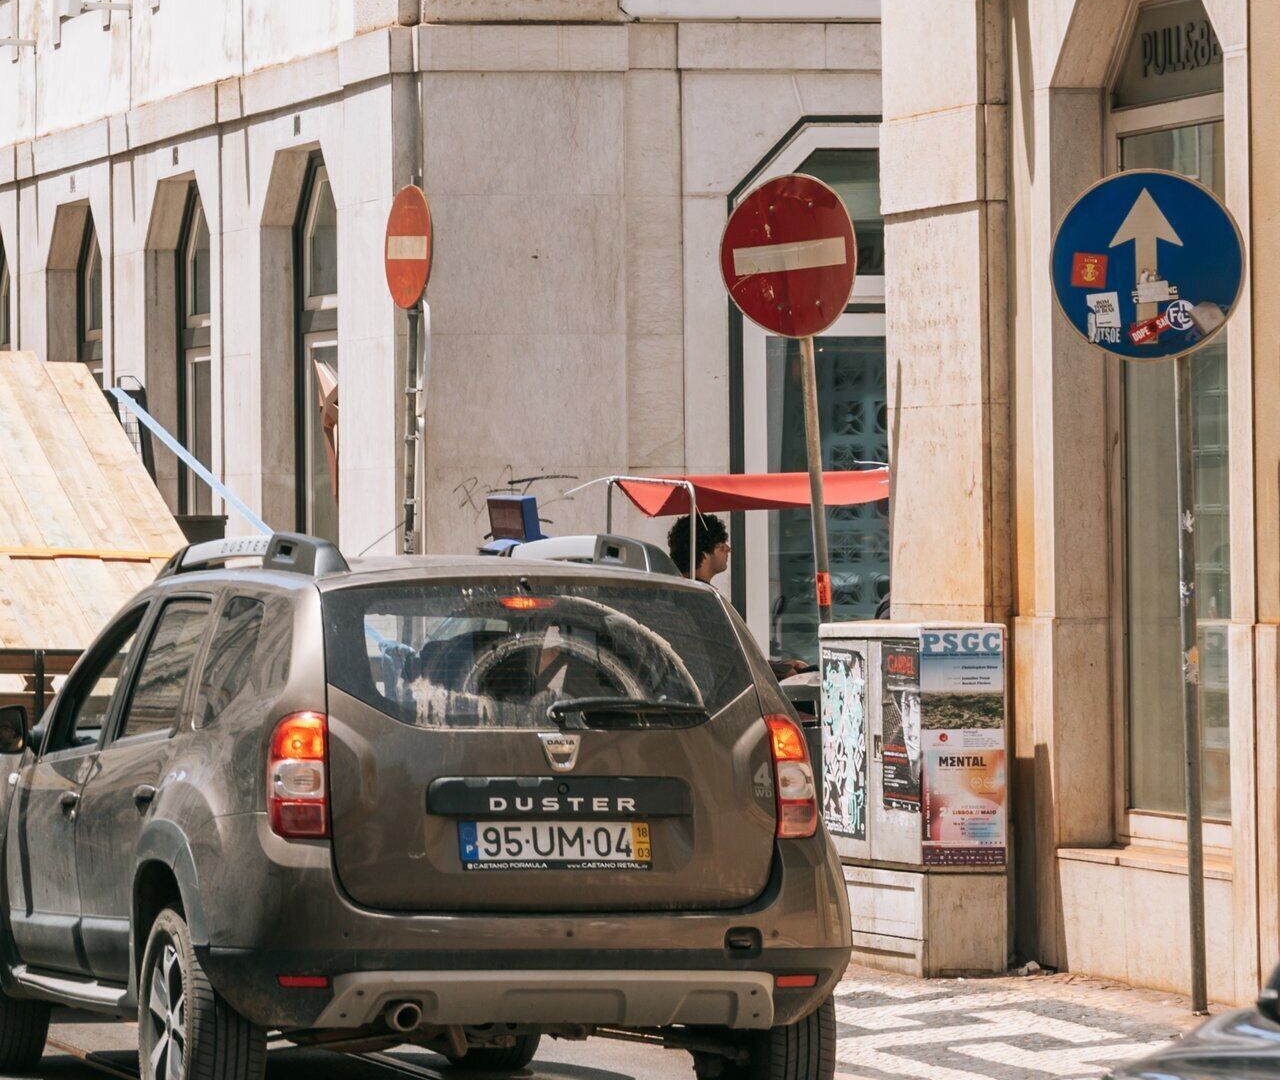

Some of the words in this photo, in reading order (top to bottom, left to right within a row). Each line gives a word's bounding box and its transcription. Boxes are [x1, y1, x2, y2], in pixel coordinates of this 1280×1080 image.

[1131, 326, 1151, 342] DOPE
[220, 540, 269, 554] DUSTER
[921, 632, 1001, 654] PSGC
[754, 761, 772, 786] 4
[754, 787, 772, 798] WD
[489, 797, 636, 812] DUSTER
[637, 827, 648, 838] 18
[466, 845, 473, 854] P
[638, 847, 650, 858] 03
